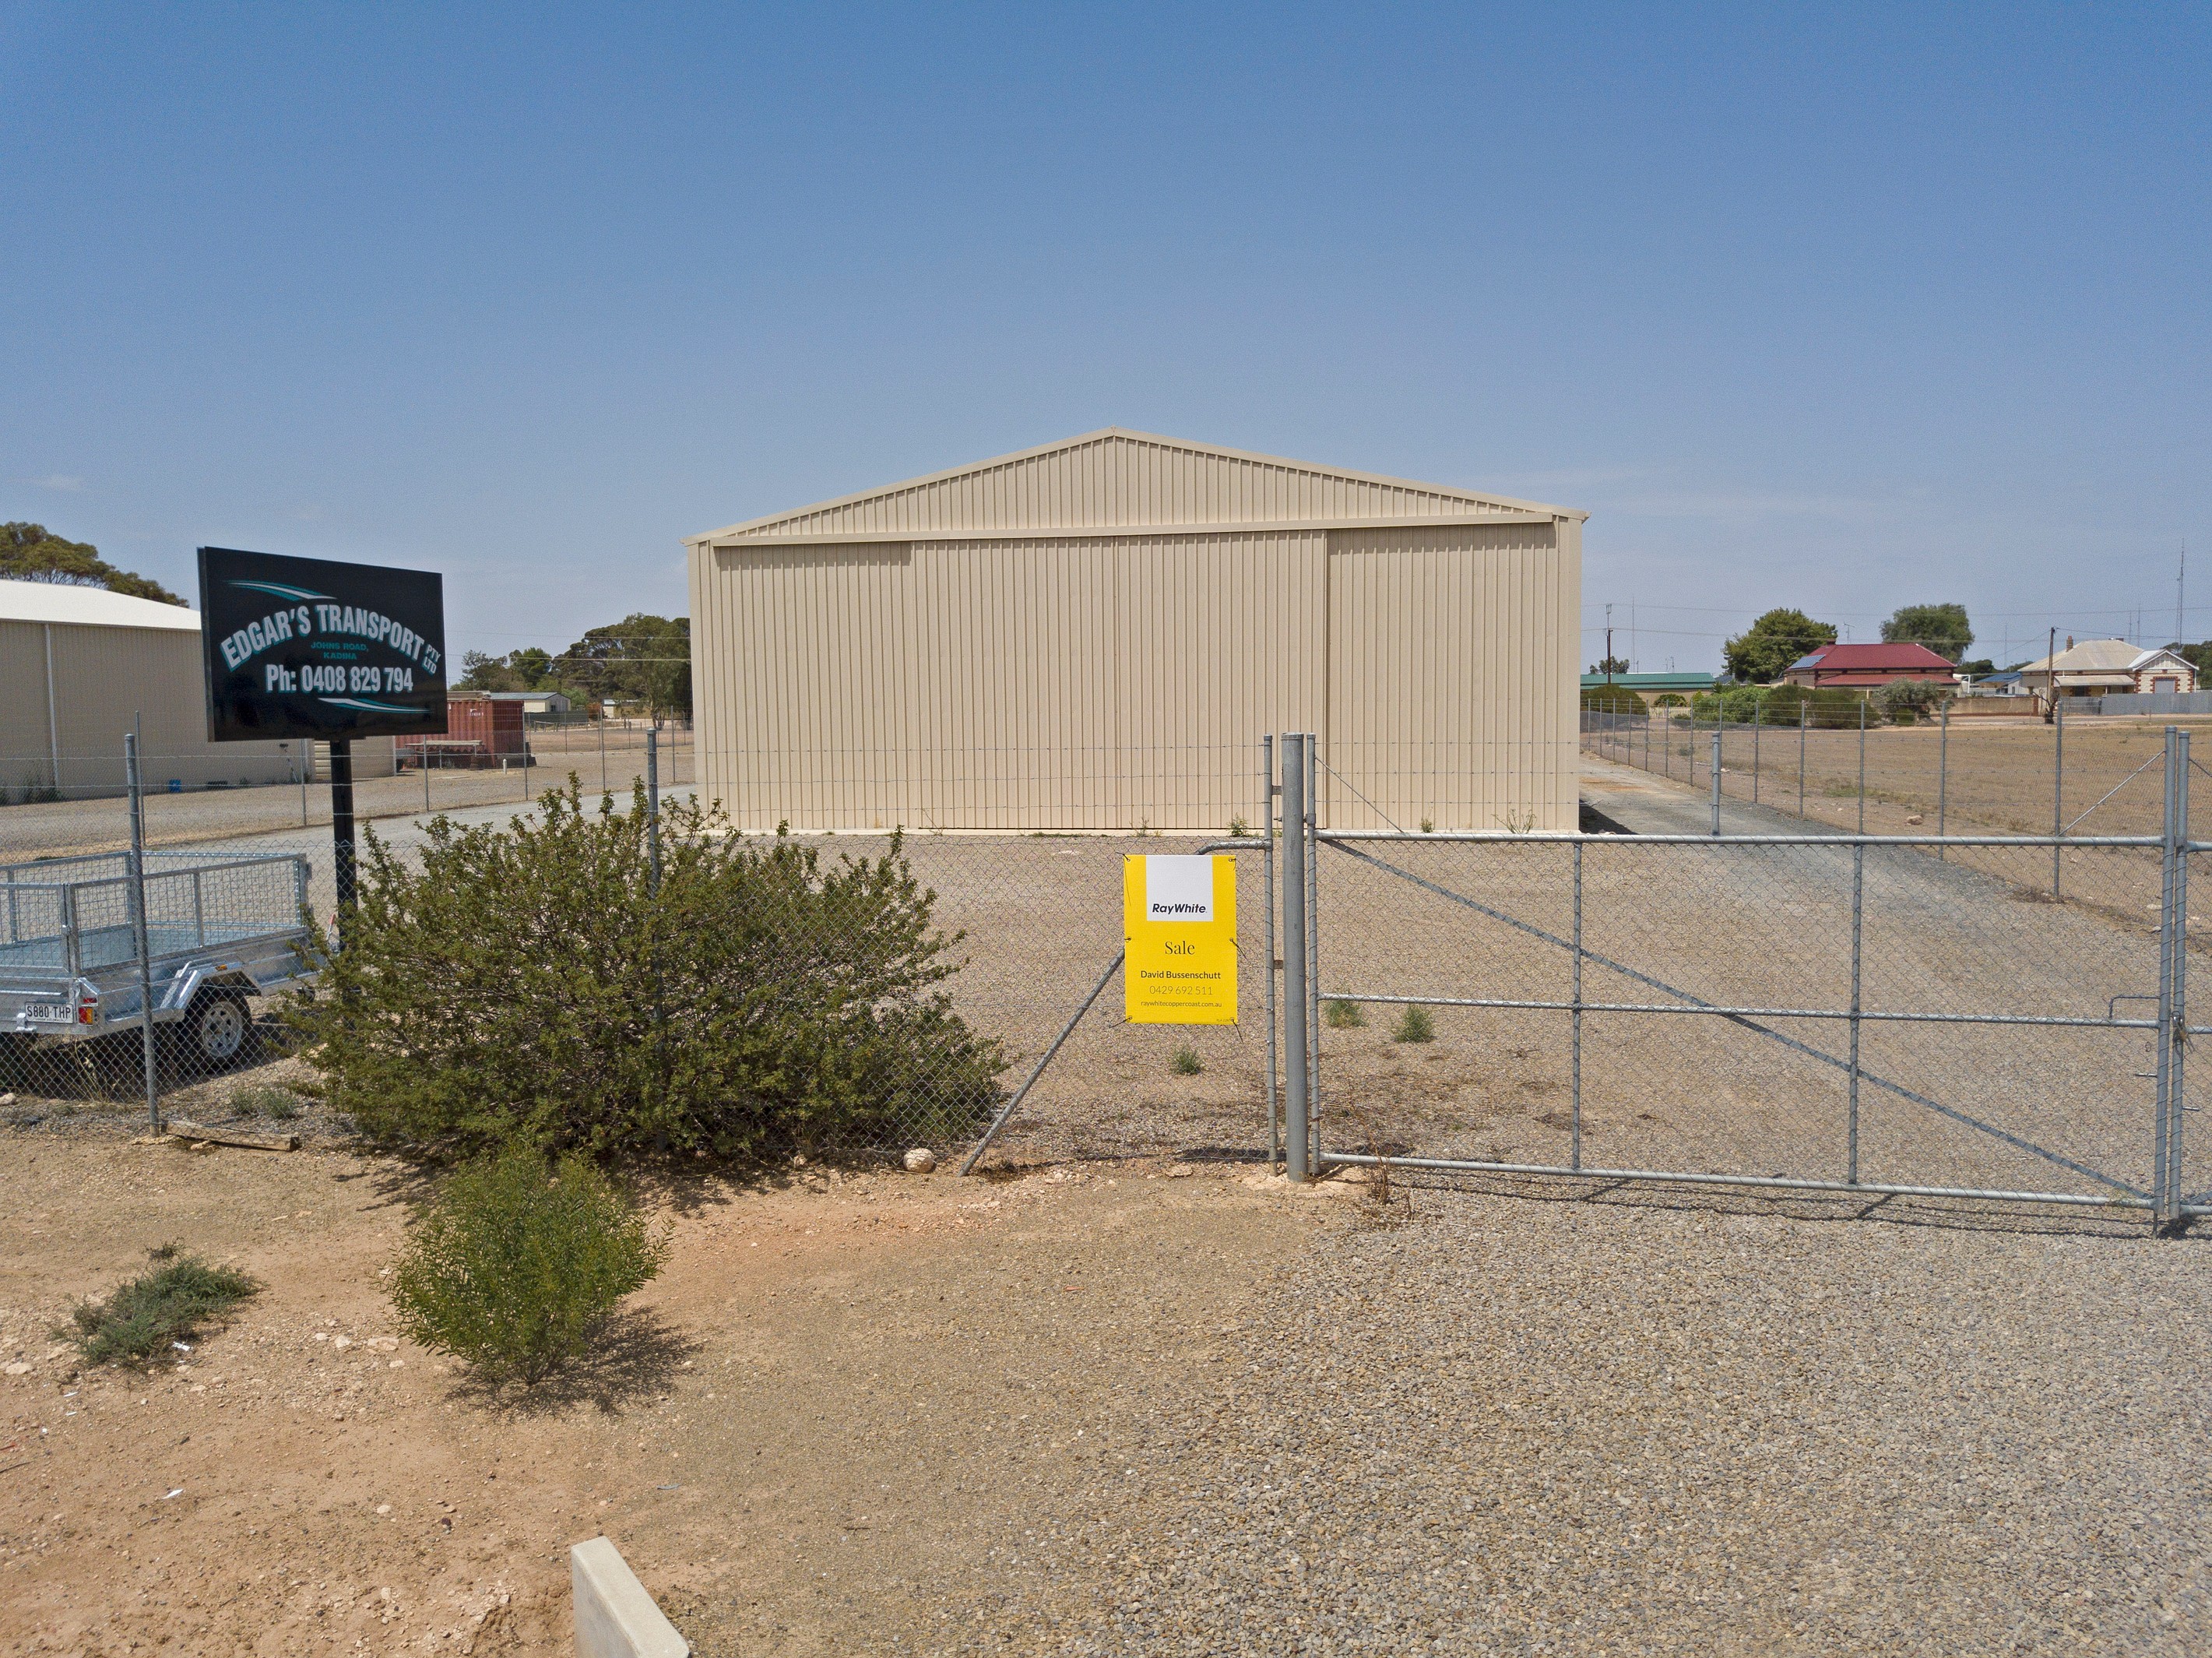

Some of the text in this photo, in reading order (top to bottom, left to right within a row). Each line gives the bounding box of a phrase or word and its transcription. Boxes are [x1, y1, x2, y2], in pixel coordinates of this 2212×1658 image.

[220, 604, 425, 672] EDGAR'S TRANSPORT
[424, 644, 441, 662] PTY
[421, 656, 438, 676] LTD
[265, 664, 413, 693] Ph: 0408 829 794
[1165, 941, 1196, 955] Sale
[1149, 985, 1213, 995] 0429 692 511
